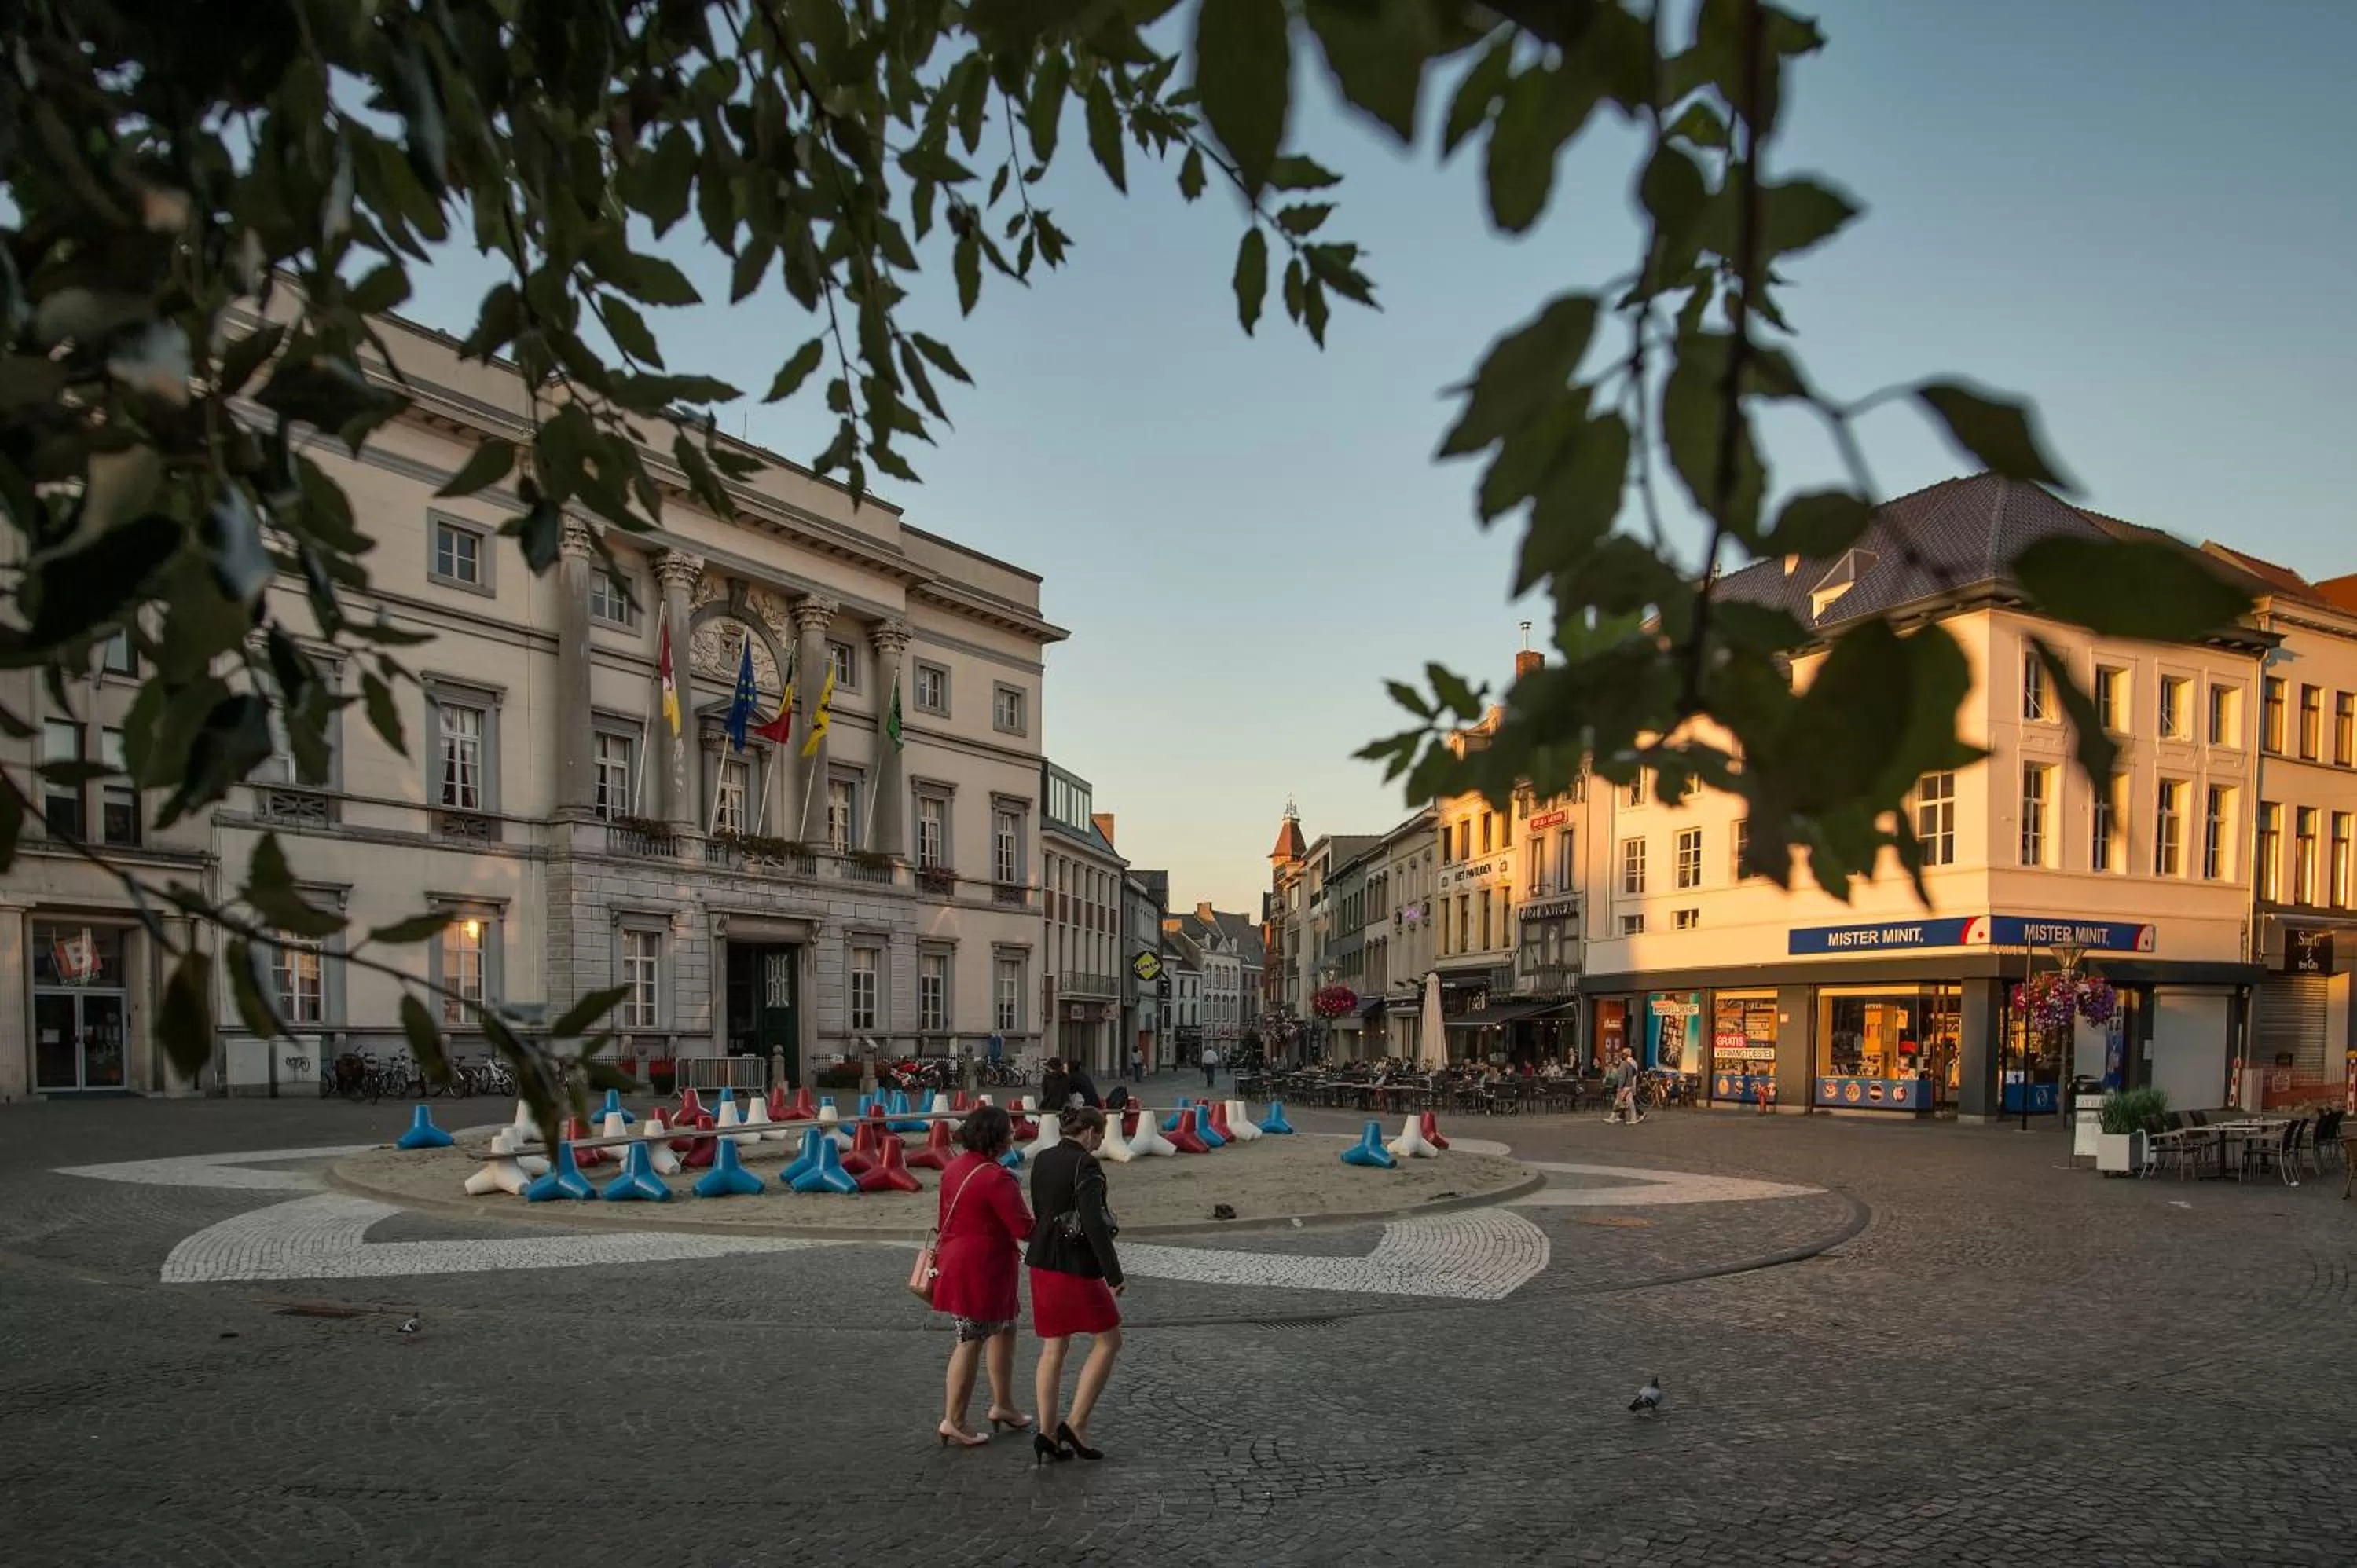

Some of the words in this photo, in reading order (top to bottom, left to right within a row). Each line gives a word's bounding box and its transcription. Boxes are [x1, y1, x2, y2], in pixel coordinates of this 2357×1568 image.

[1827, 929, 1879, 947] MISTER
[2024, 923, 2072, 941] MISTER
[1716, 1035, 1743, 1047] GRATIS
